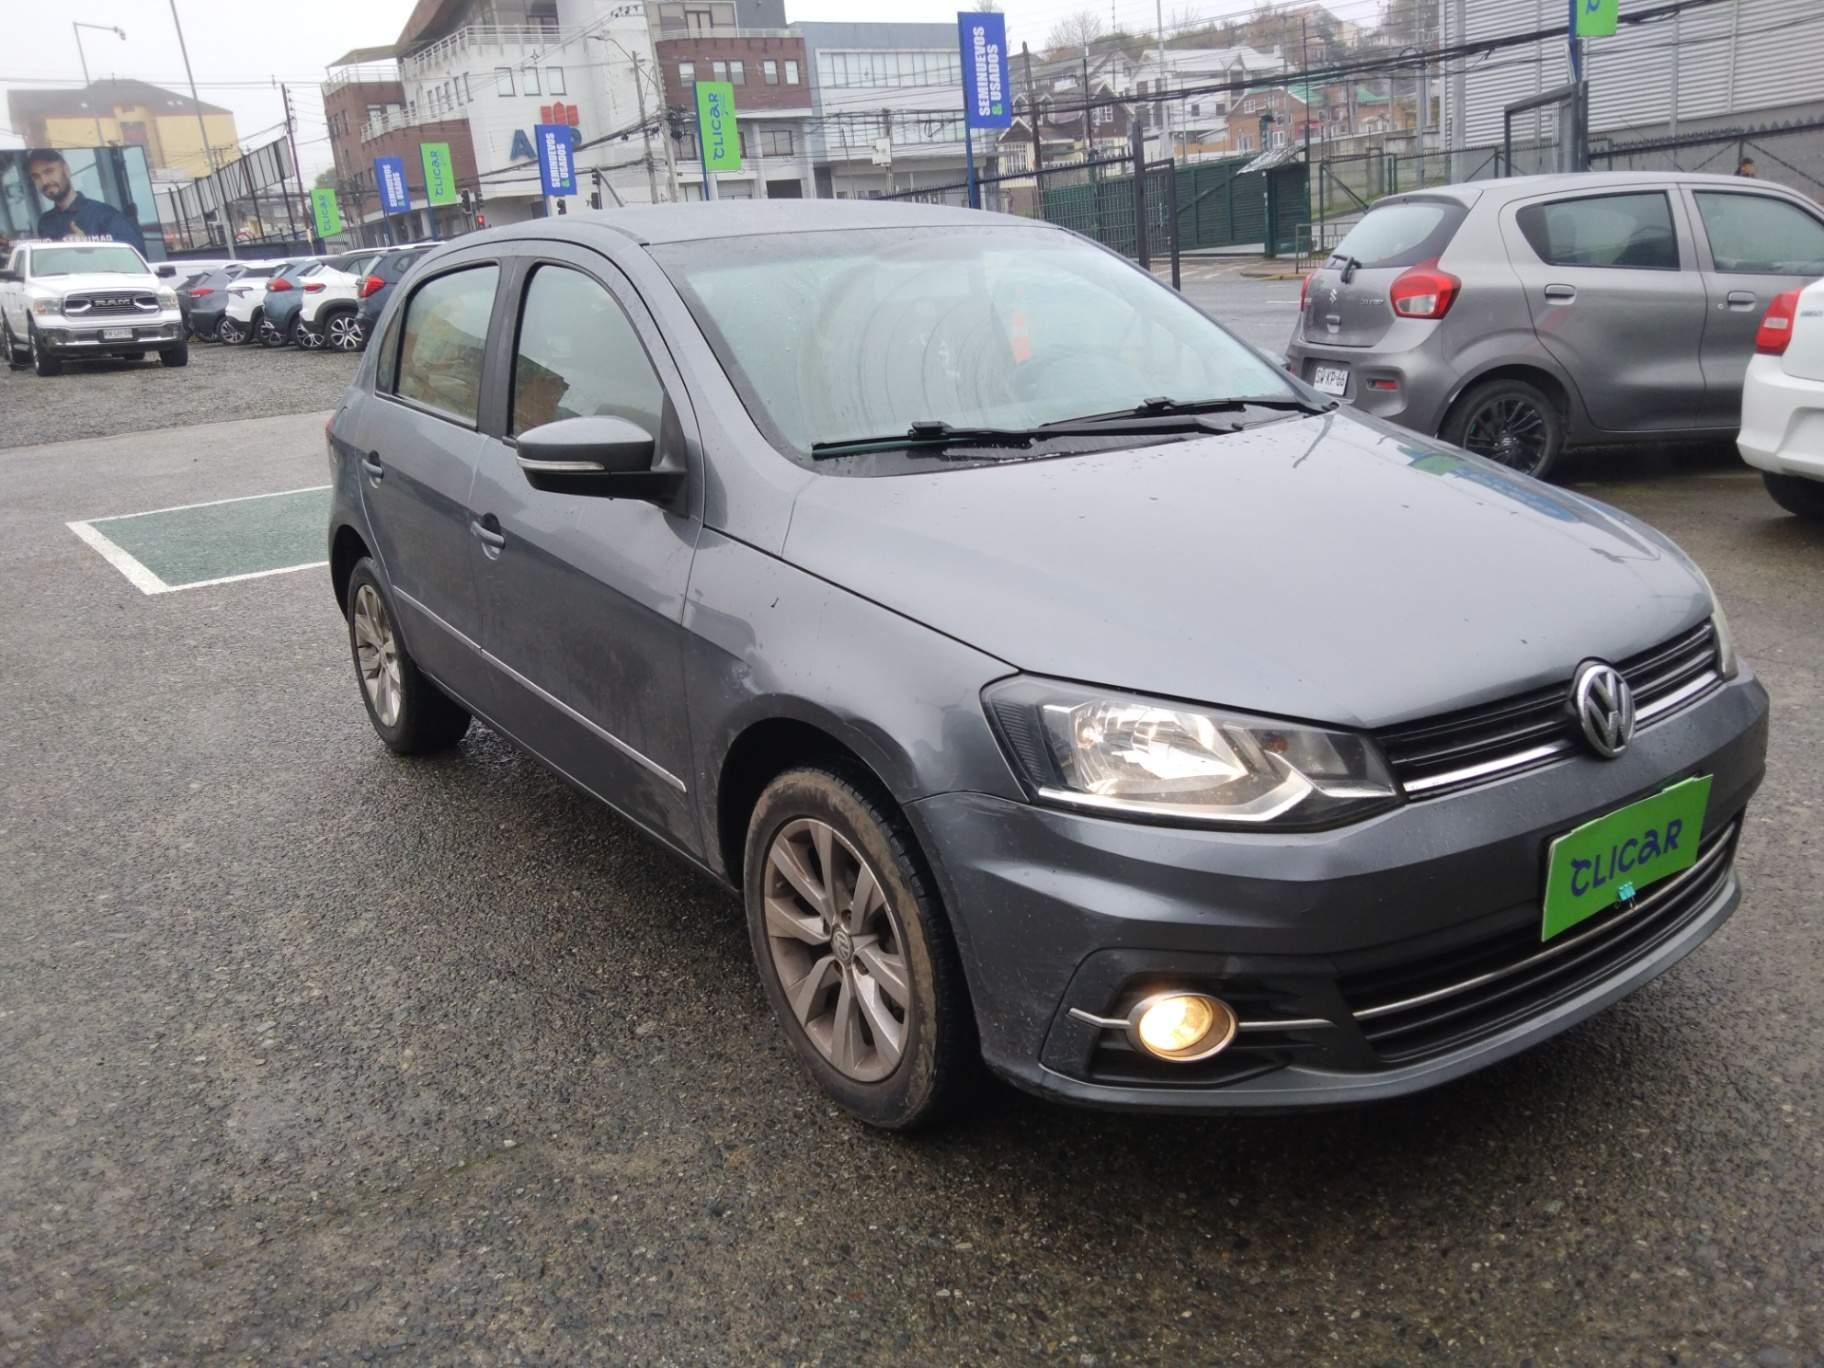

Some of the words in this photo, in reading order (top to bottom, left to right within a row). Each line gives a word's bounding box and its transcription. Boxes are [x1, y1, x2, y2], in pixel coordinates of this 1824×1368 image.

[973, 26, 990, 116] SEMINUEVOS
[987, 44, 1001, 101] USADOS
[545, 132, 561, 188] SEMINUEVOS
[556, 143, 569, 179] USADOS
